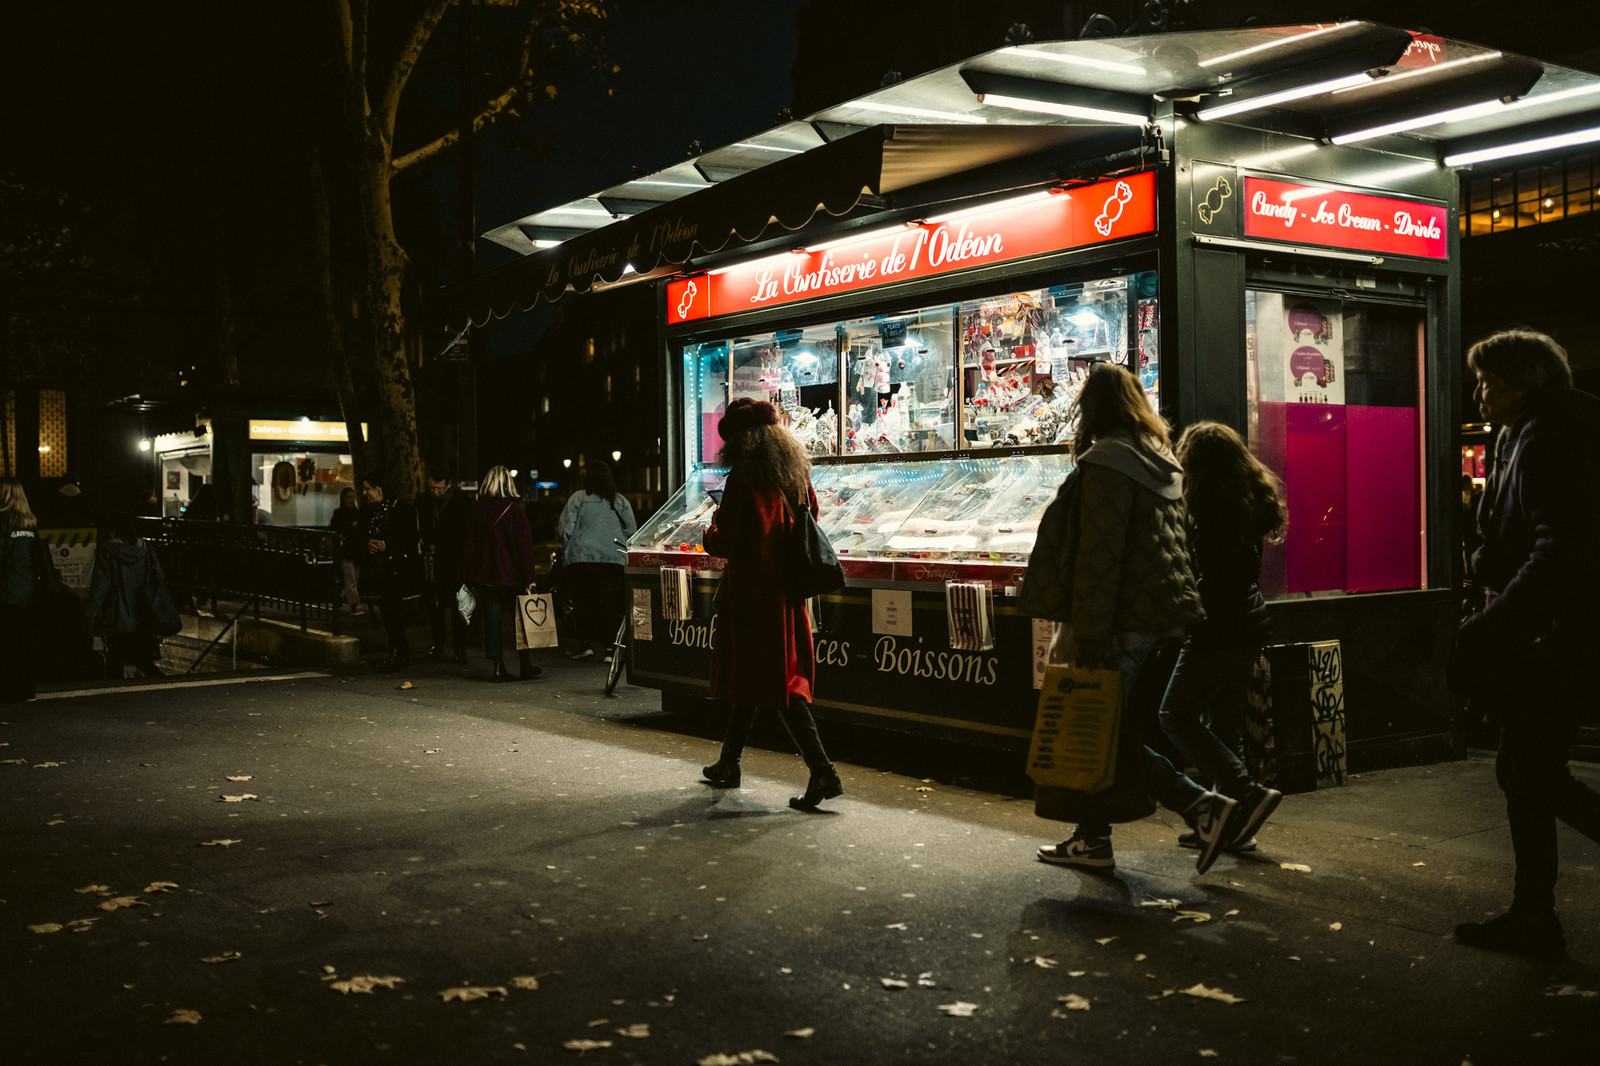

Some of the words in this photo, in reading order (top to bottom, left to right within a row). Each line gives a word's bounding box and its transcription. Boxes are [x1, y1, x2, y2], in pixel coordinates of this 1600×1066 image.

[1252, 190, 1297, 227] Candy
[1311, 200, 1335, 225] Ice
[1338, 203, 1381, 231] Cream
[1394, 211, 1441, 239] Drinks
[568, 247, 620, 279] Confiserie
[627, 232, 641, 259] de
[649, 216, 698, 252] l'Odéon
[750, 269, 779, 303] La
[784, 251, 877, 294] Confiserie
[881, 241, 907, 275] de
[909, 223, 1004, 271] l'Odéon
[815, 637, 850, 667] ces
[874, 635, 999, 686] Boissons
